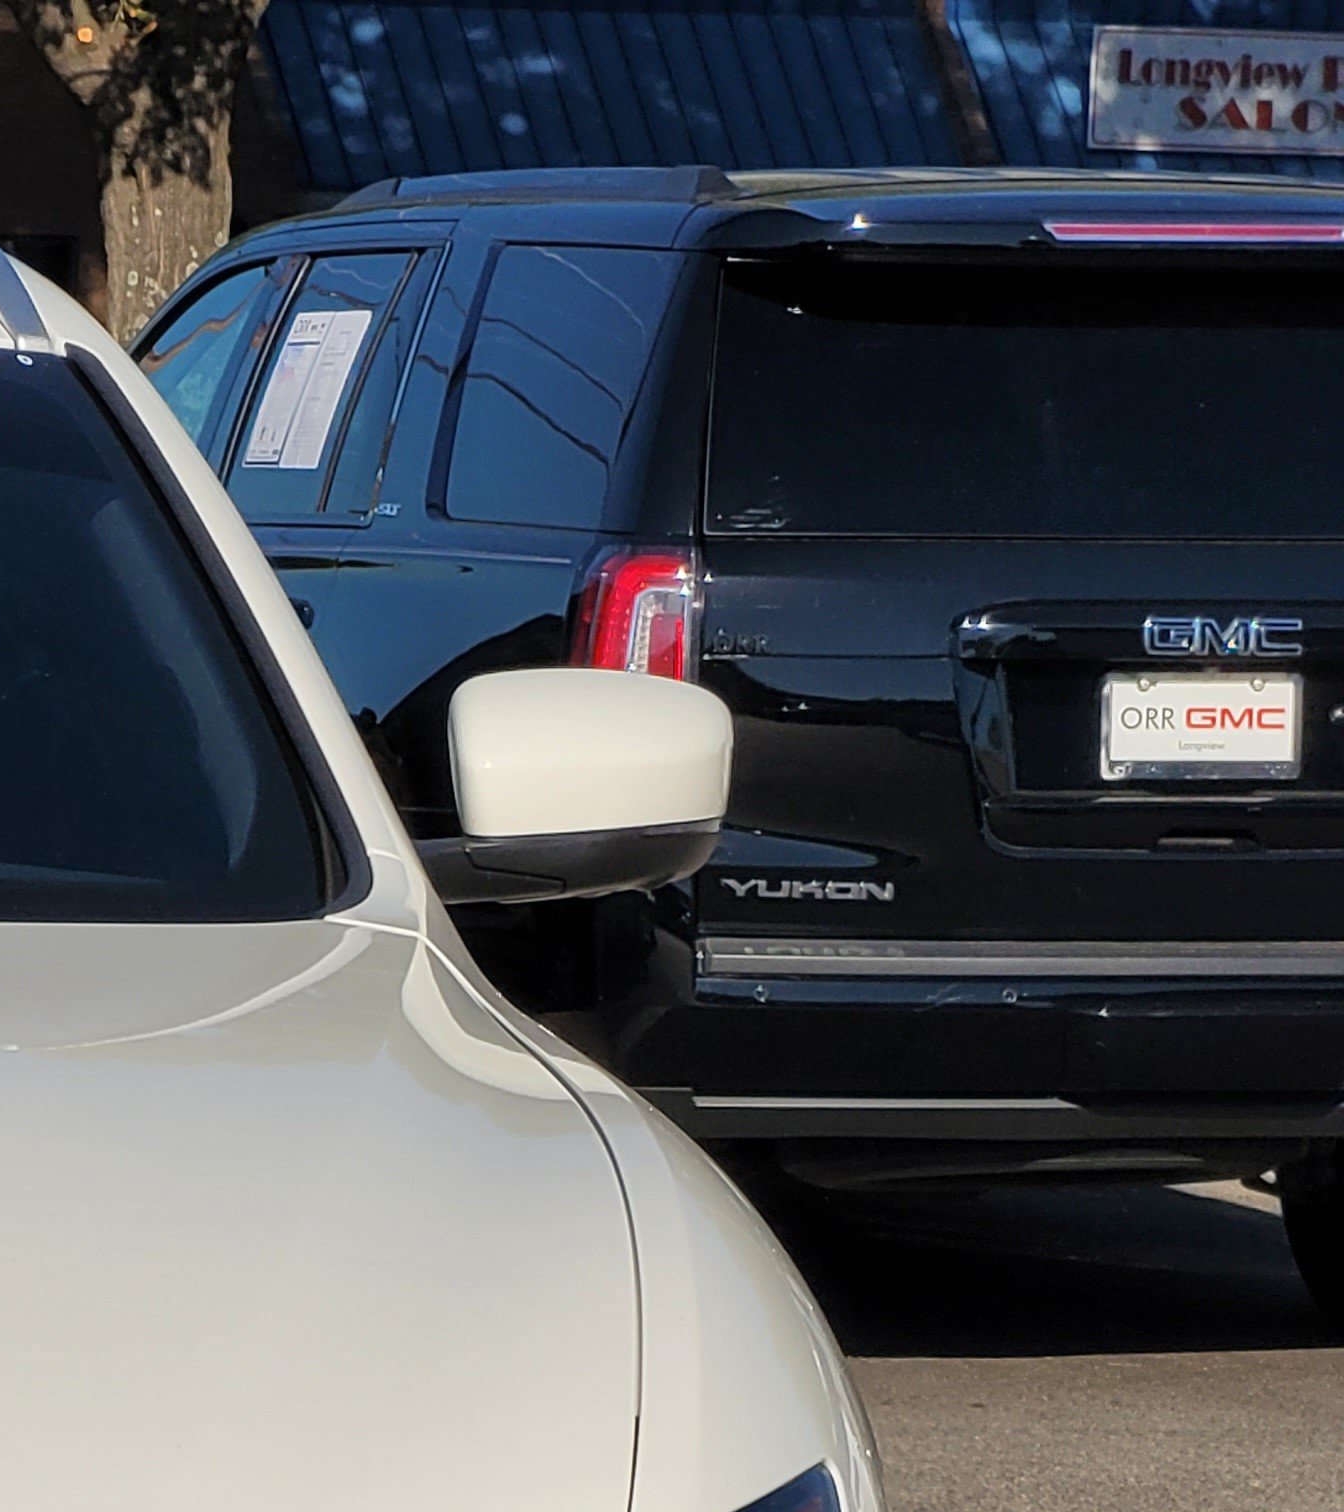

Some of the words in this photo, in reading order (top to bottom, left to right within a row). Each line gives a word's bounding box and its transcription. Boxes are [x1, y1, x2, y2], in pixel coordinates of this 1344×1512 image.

[1116, 48, 1310, 93] Longview
[1143, 615, 1303, 657] GMC
[1120, 706, 1176, 730] ORR
[1184, 707, 1286, 730] GMC
[1177, 739, 1227, 753] Longview
[719, 877, 895, 901] YUKON
